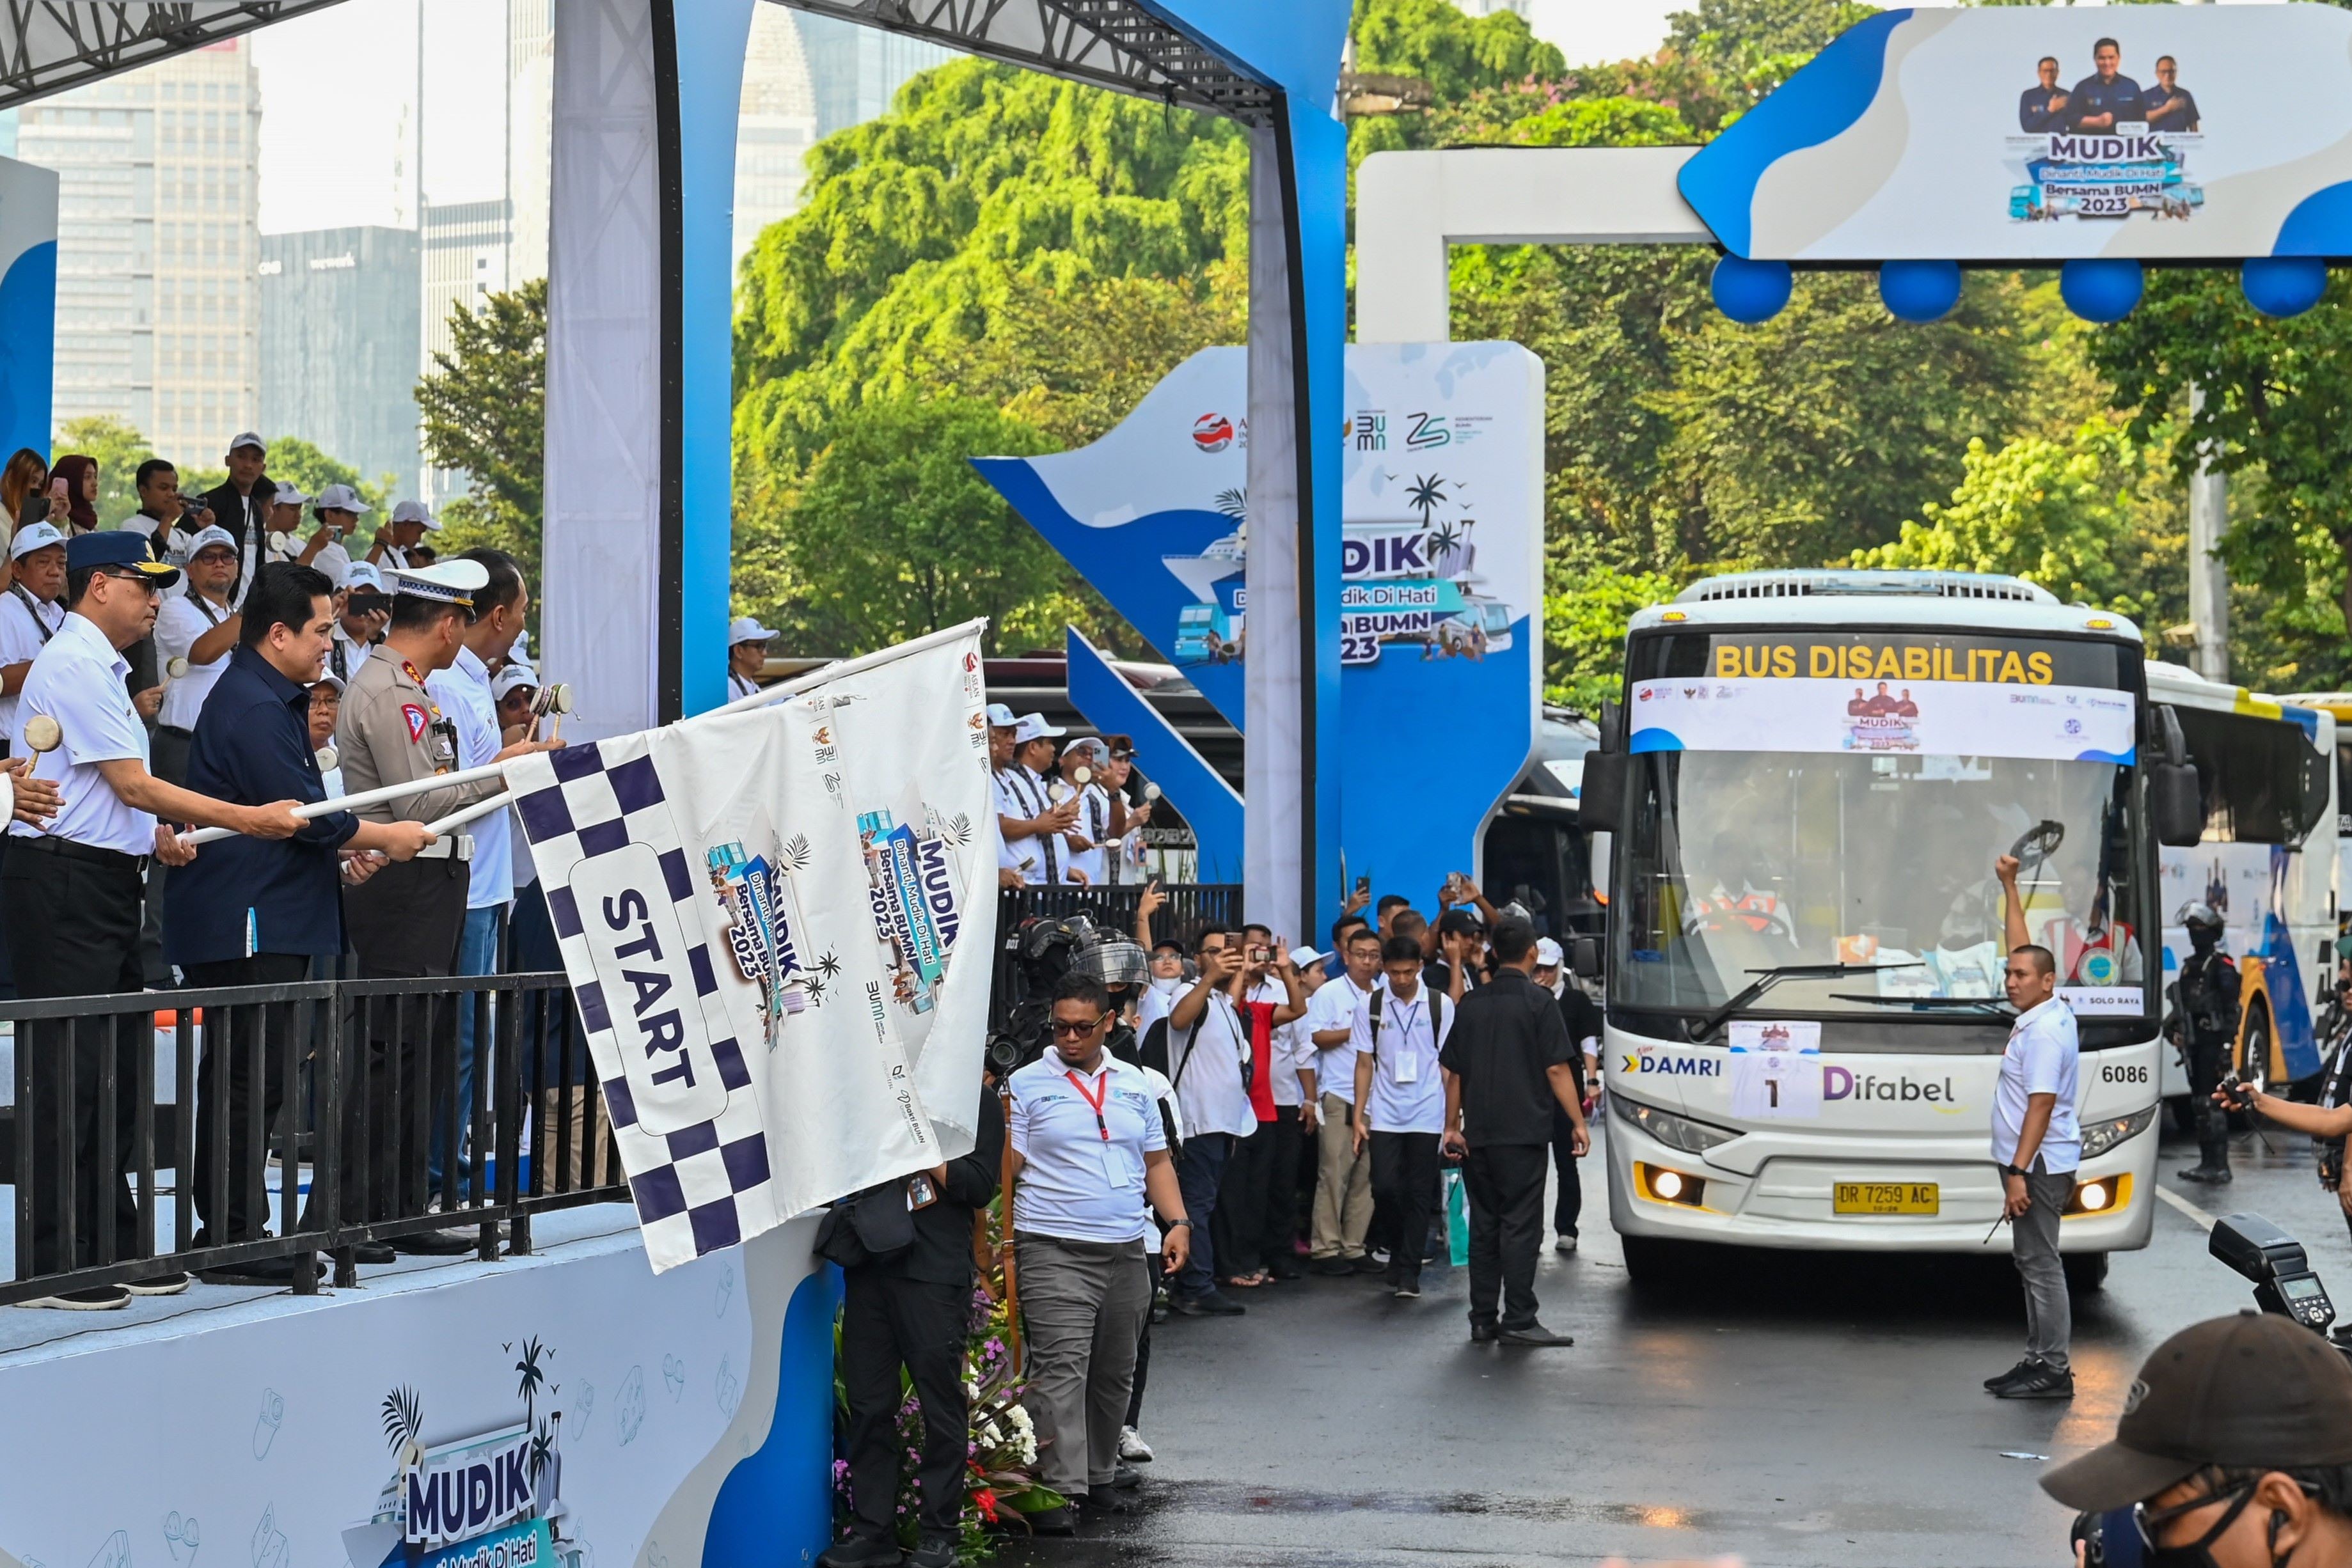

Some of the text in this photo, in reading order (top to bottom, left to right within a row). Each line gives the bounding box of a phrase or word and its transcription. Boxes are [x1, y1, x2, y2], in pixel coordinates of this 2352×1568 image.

[2051, 136, 2157, 159] MUDIK
[2046, 184, 2159, 196] Bersama BUMN
[2081, 198, 2127, 212] 2023
[1342, 533, 1426, 574] DIK
[1342, 587, 1435, 604] dik Di Hati
[1355, 612, 1428, 633] BUMN
[1342, 637, 1377, 659] 23
[1716, 645, 2053, 685] BUS DISABILITAS
[1859, 718, 1900, 727] MUDIK
[750, 873, 769, 920] Dinanti,
[880, 849, 917, 959] Bersama BUMN
[894, 840, 935, 964] Dinanti, Mudik Di Hati
[920, 840, 959, 948] MUDIK
[736, 883, 763, 950] Bersama
[870, 888, 896, 937] 2023
[730, 927, 761, 978] 2023
[603, 888, 697, 1089] START
[1640, 1056, 1721, 1076] DAMRI
[1824, 1066, 1955, 1102] Difabel
[2102, 1066, 2147, 1083] 6086
[1765, 1079, 1778, 1108] 1
[905, 1104, 925, 1143] Bakti BUMN
[1840, 1186, 1930, 1203] DR 7259 AC
[409, 1441, 530, 1535] MUDIK
[495, 1541, 508, 1568] Di
[512, 1533, 535, 1565] Hati
